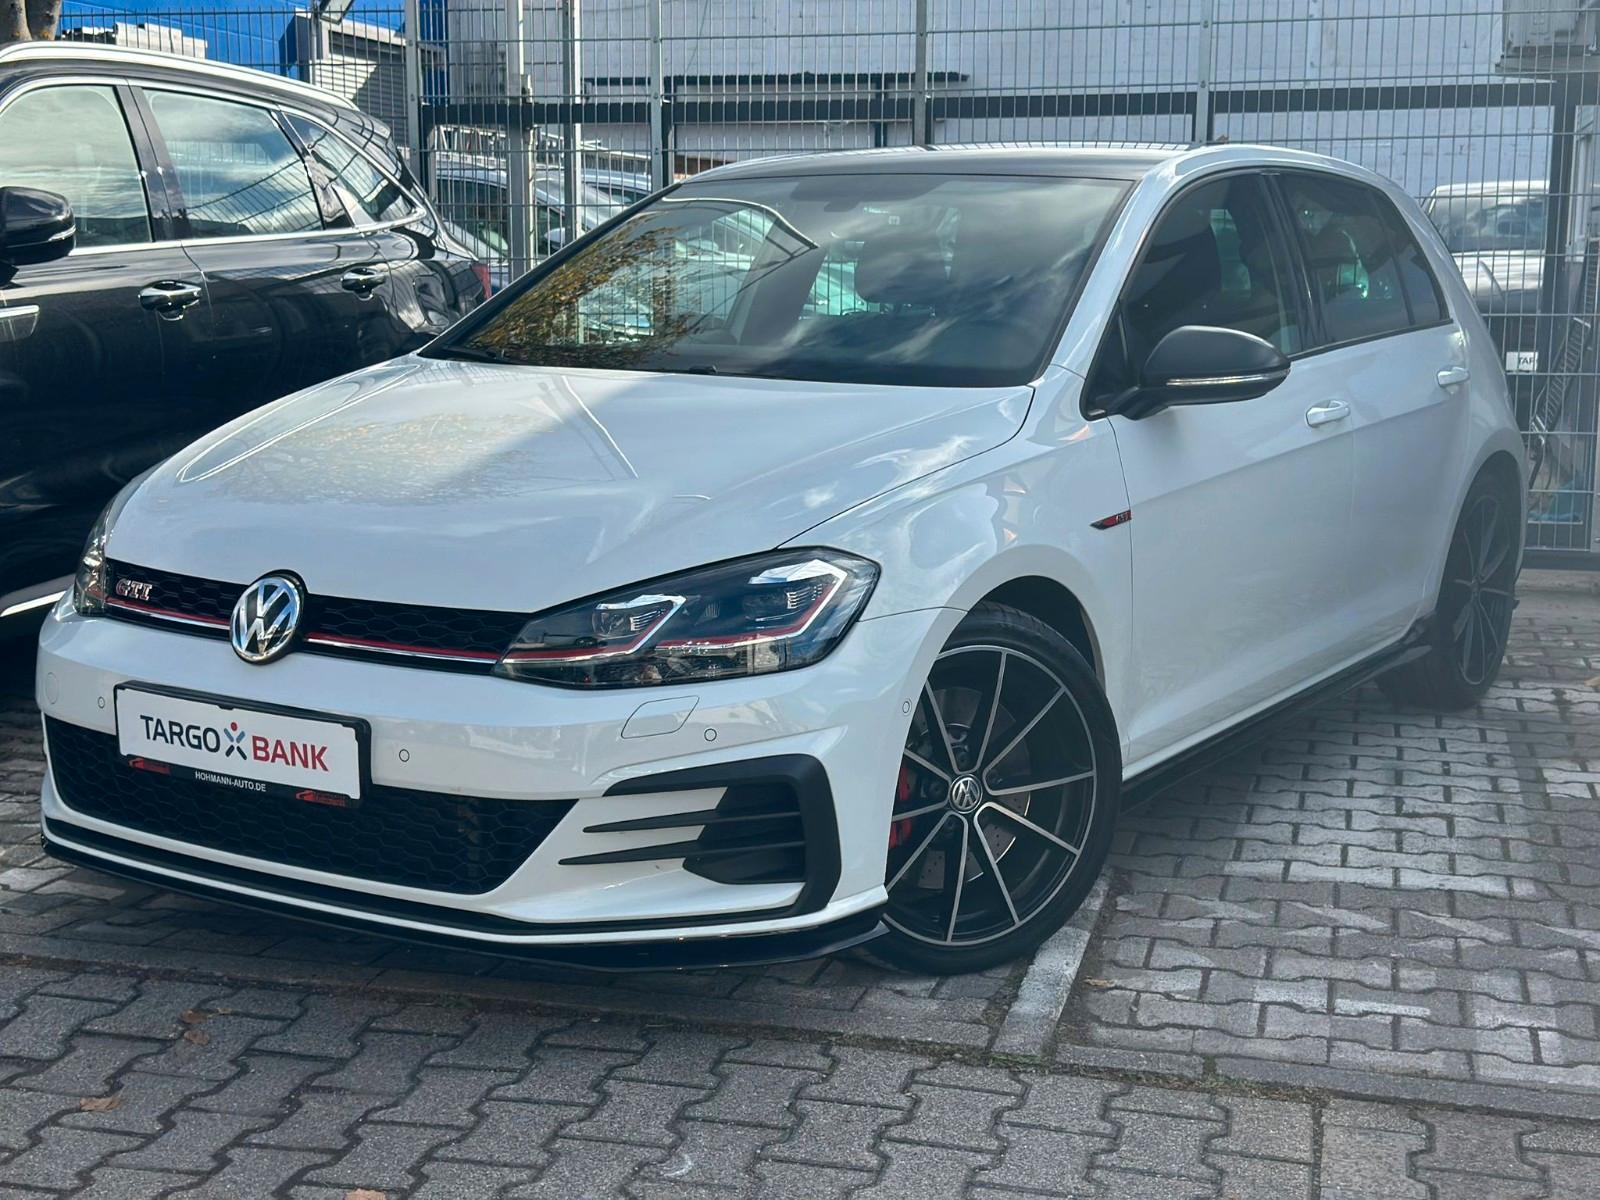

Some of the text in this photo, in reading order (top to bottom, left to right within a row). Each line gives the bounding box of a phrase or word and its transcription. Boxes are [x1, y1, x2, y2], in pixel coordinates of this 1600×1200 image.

[116, 578, 152, 600] GTI
[140, 715, 329, 772] TARGO BANK
[195, 771, 267, 792] HOHMANN-AUTO.DE
